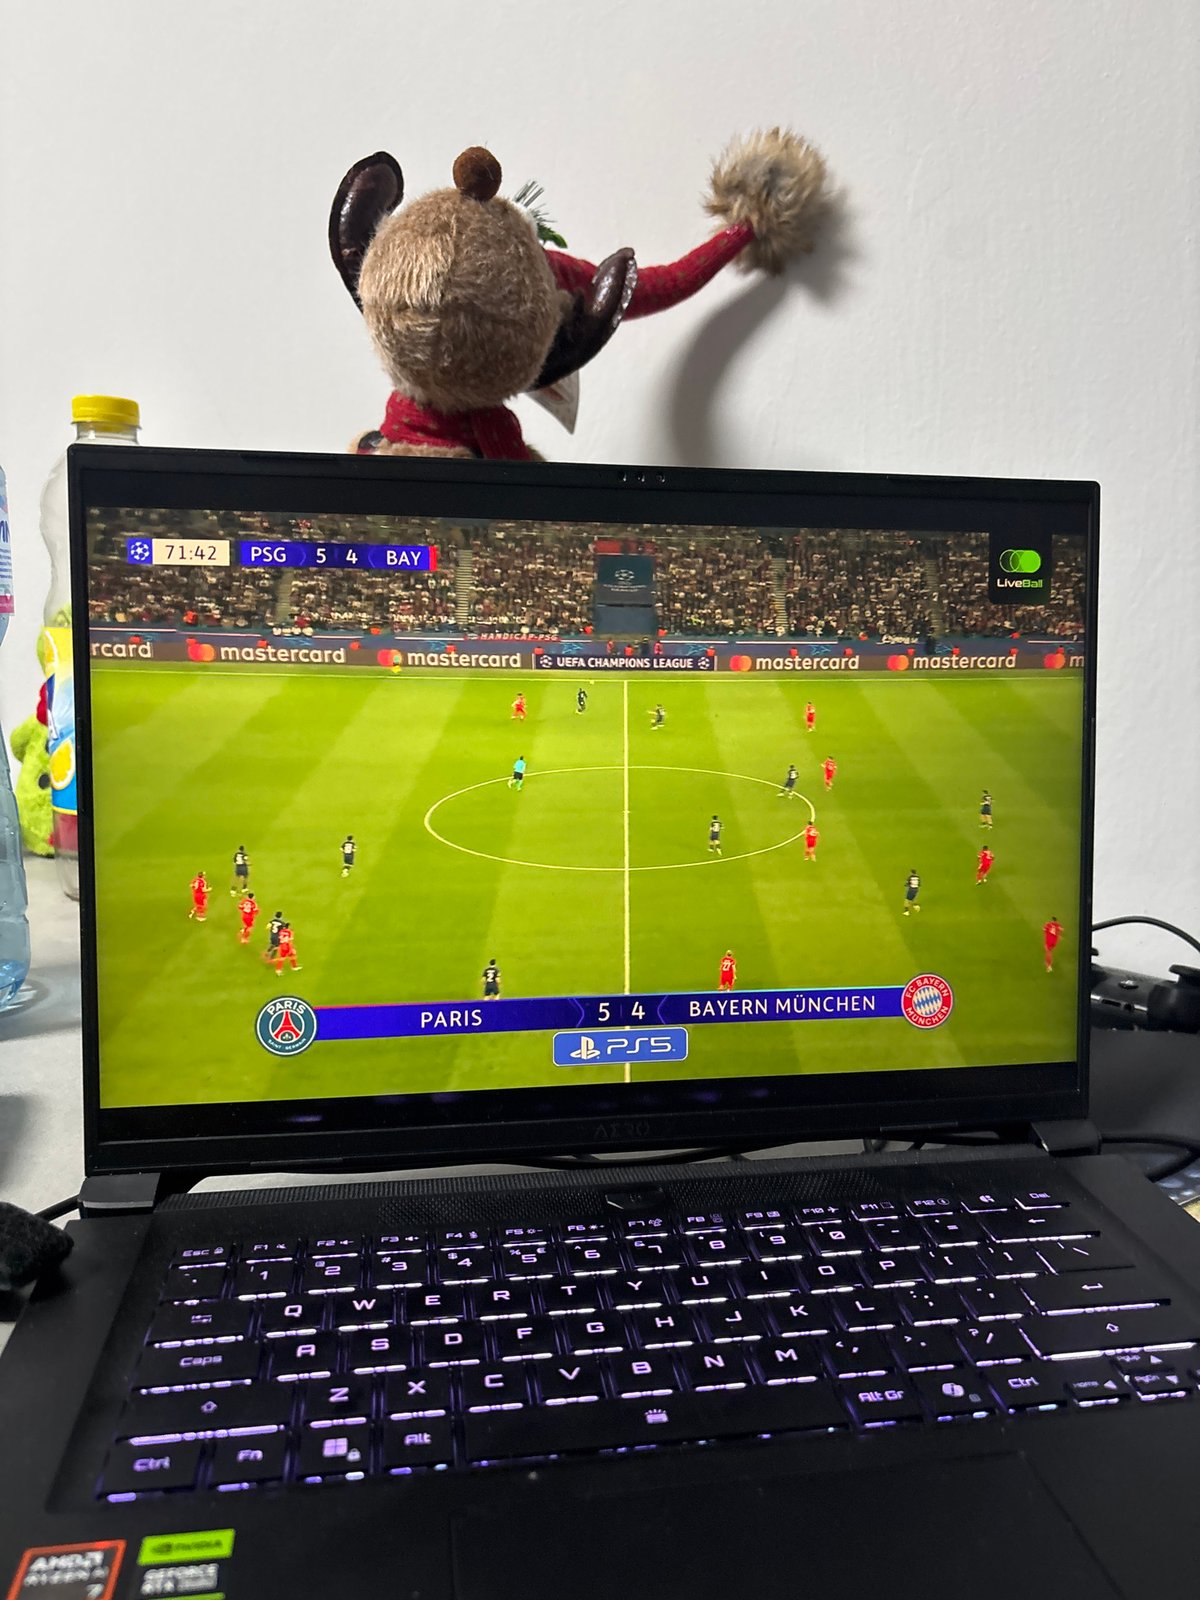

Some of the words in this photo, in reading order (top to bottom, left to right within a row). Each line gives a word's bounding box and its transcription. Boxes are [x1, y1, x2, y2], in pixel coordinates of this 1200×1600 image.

[164, 543, 218, 562] 71:42
[250, 546, 287, 564] PSG
[315, 547, 327, 564] 5
[345, 548, 358, 565] 4
[386, 550, 421, 567] BAY
[996, 578, 1043, 588] LiveBall
[91, 641, 152, 658] rcard
[219, 644, 347, 665] mastercard
[407, 650, 522, 668] mastercard
[556, 656, 586, 668] UEFA
[587, 656, 651, 669] CHAMPIONS
[653, 657, 694, 669] LEAGUE
[755, 654, 860, 671] mastercard
[912, 653, 1017, 670] mastercard
[915, 977, 949, 997] BAYERN
[266, 1000, 307, 1015] PARIS
[598, 1002, 611, 1021] 5
[631, 1001, 646, 1020] 4
[689, 997, 768, 1017] BAYERN
[775, 994, 876, 1016] MÜNCHEN
[420, 1009, 483, 1029] PARIS
[607, 1035, 673, 1055] PS5
[802, 1207, 825, 1216] F10
[316, 1239, 336, 1247] F2
[708, 1239, 726, 1250] 8
[769, 1235, 787, 1245] 9
[520, 1253, 538, 1264] 5
[584, 1249, 601, 1259] 6
[391, 1261, 408, 1272] 3
[457, 1257, 473, 1267] 4
[878, 1260, 896, 1271] P
[323, 1264, 341, 1276] 2
[626, 1280, 643, 1291] Y
[691, 1275, 710, 1286] U
[492, 1290, 511, 1301] R
[560, 1285, 577, 1296] T
[352, 1298, 377, 1311] W
[424, 1294, 441, 1306] E
[855, 1300, 875, 1312] L
[284, 1304, 303, 1318] Q
[725, 1310, 743, 1322] J
[789, 1305, 809, 1317] K
[586, 1321, 605, 1334] G
[654, 1316, 675, 1328] H
[444, 1332, 463, 1345] D
[516, 1327, 533, 1340] F
[370, 1337, 390, 1351] S
[296, 1344, 316, 1358] A
[774, 1348, 798, 1362] M
[179, 1355, 223, 1367] Caps
[703, 1354, 725, 1368] N
[558, 1366, 581, 1380] V
[631, 1361, 652, 1375] B
[484, 1373, 505, 1388] C
[407, 1380, 426, 1395] X
[328, 1387, 350, 1403] Z
[858, 1391, 884, 1402] Alt
[404, 1432, 431, 1445] Alt
